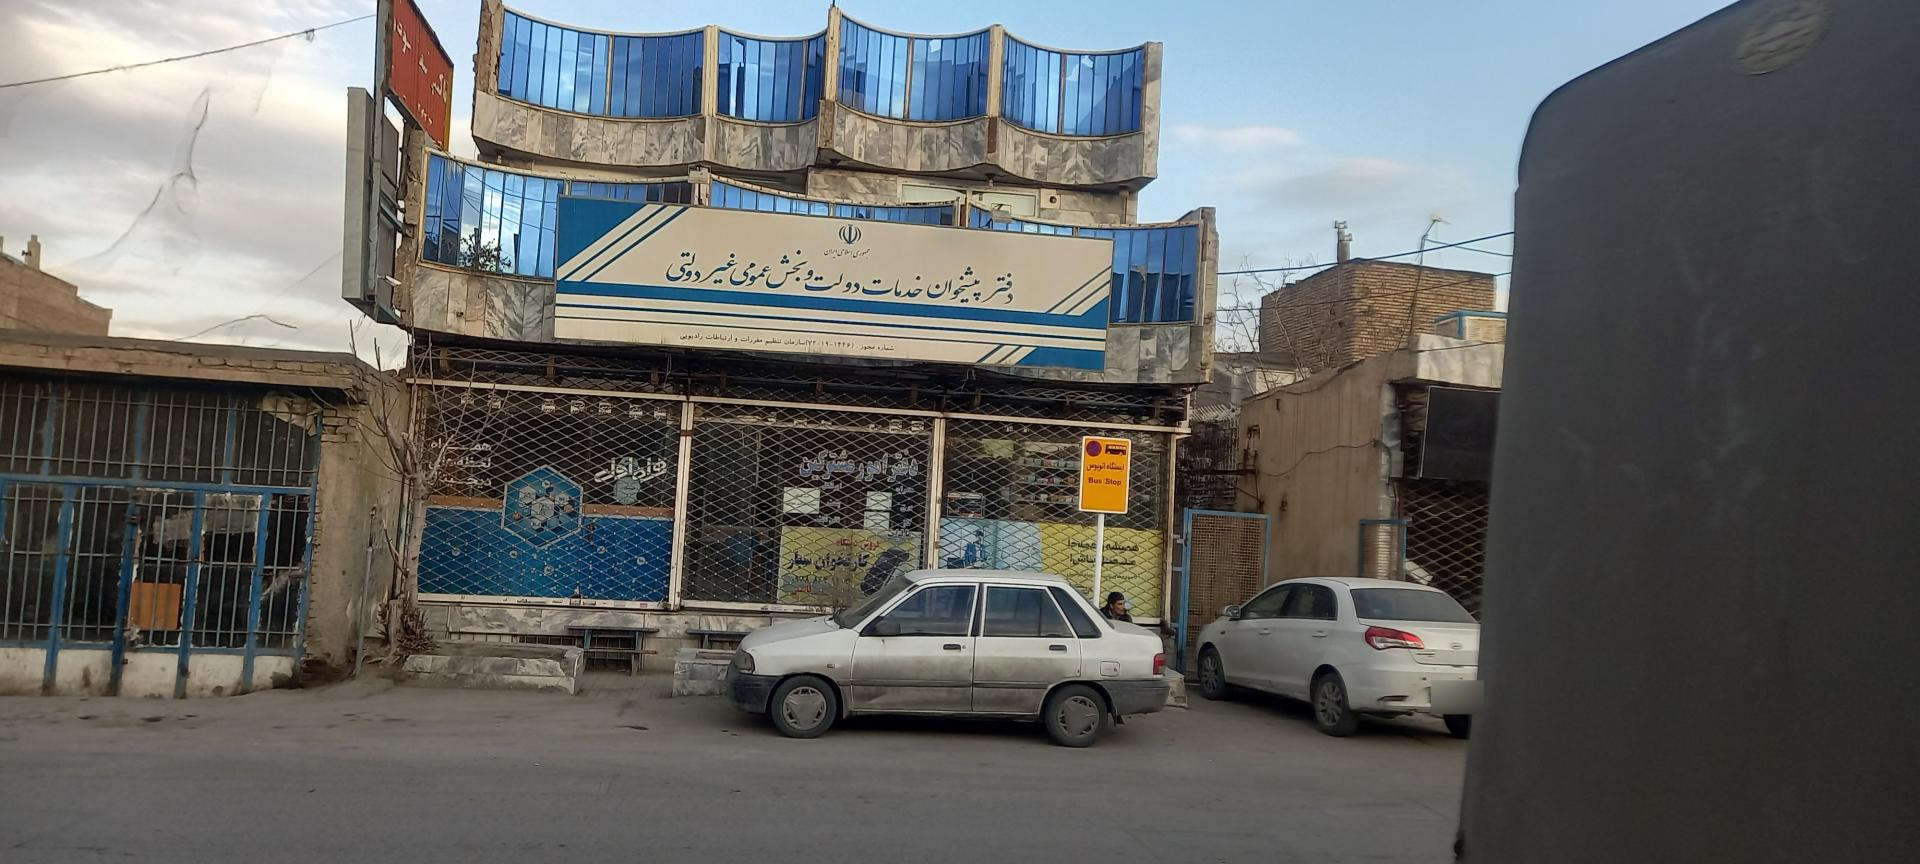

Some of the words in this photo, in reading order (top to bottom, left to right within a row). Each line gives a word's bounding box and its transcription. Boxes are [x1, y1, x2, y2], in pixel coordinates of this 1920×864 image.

[823, 248, 838, 258] ایران
[837, 248, 853, 256] اسلامی
[852, 248, 871, 259] جمهوری
[665, 251, 702, 283] دولتی
[698, 252, 738, 284] غیر
[729, 262, 772, 287] عمومی
[766, 249, 809, 288] بخش
[803, 269, 814, 281] و
[804, 273, 860, 294] دولت
[862, 275, 923, 298] خدمات
[926, 266, 980, 303] پیشخوان
[982, 272, 1014, 304] دفتر
[679, 332, 703, 341] رادیویی
[705, 333, 733, 343] ارتباطات
[740, 335, 763, 344] مقررات
[764, 337, 782, 345] تنظیم
[594, 456, 633, 483] اول
[799, 448, 856, 481] مشترکین
[855, 452, 888, 482] امور
[887, 449, 919, 483] دفتر
[1086, 463, 1106, 472] اتوبوس
[1106, 462, 1125, 472] ایستگاه
[1105, 478, 1122, 487] Stop
